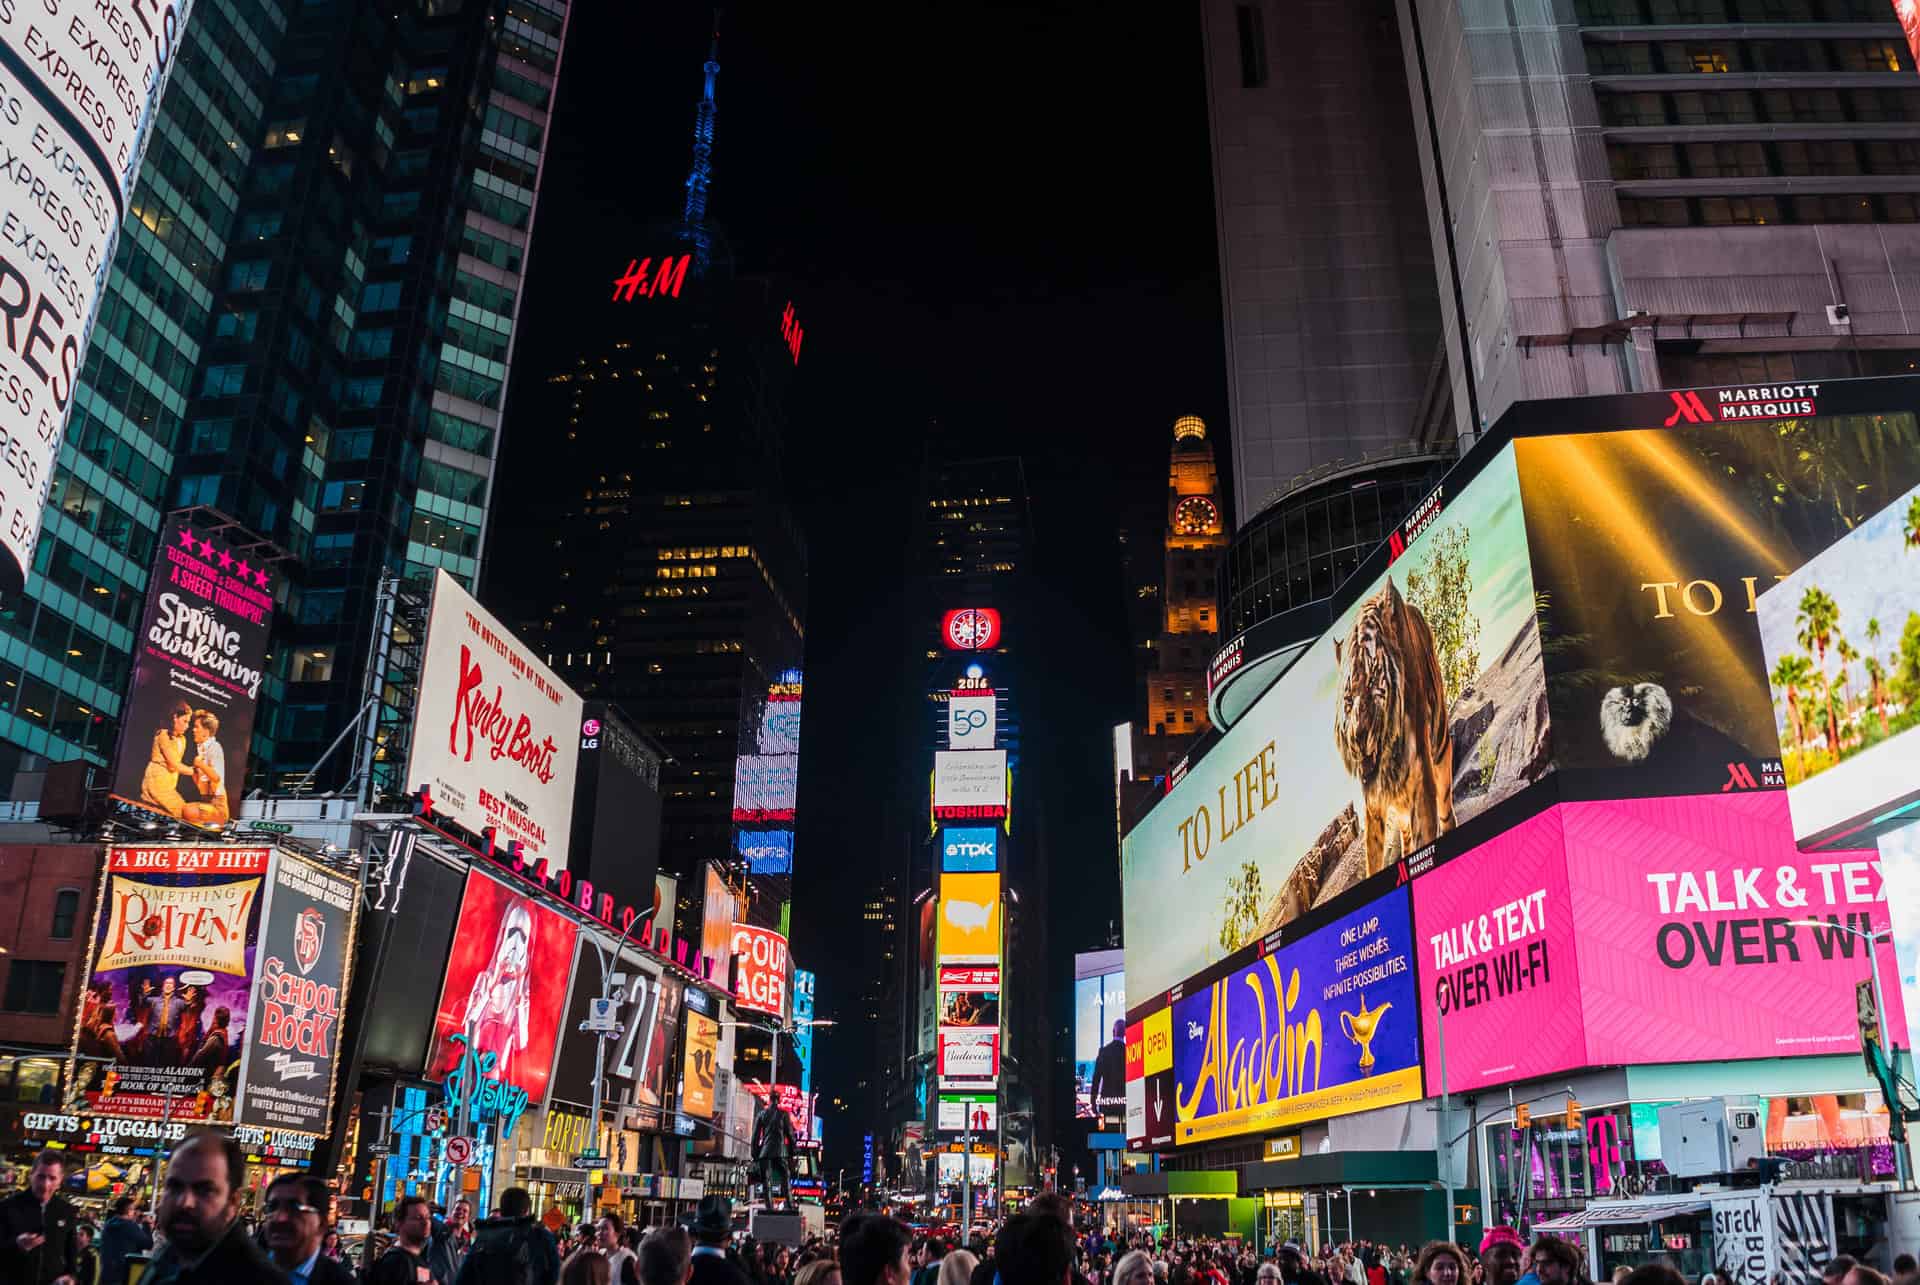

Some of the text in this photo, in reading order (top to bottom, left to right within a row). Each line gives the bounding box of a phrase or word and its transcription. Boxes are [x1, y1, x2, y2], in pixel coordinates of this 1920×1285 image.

[24, 24, 116, 144] EXPRESS
[68, 15, 142, 131] EXPRESS
[31, 123, 110, 235] EXPRESS
[2, 211, 84, 320] EXPRESS
[611, 254, 691, 302] H&M
[1718, 385, 1820, 403] MARRIOTT
[1721, 401, 1813, 419] MARQUIS
[1405, 485, 1443, 532] MARRIOTT
[1407, 505, 1441, 546] MARQUIS
[170, 565, 180, 585] A
[180, 569, 214, 601] SHEER
[1640, 579, 1723, 619] TO
[157, 592, 240, 657] SPRING
[149, 625, 263, 700] awakening
[449, 643, 512, 763] Kinky
[951, 689, 994, 697] TOSHIBA
[958, 678, 988, 689] 2016
[582, 738, 598, 749] LG
[954, 710, 987, 737] 50
[507, 712, 558, 784] Boots
[478, 788, 506, 820] BEST
[507, 806, 546, 845] MUSICAL
[935, 806, 1006, 818] TOSHIBA
[1178, 740, 1280, 875] TO LIFE
[176, 851, 212, 867] FAT
[957, 843, 994, 857] TDK
[132, 887, 236, 902] SOMETHING
[1647, 867, 1770, 914] TALK
[1776, 865, 1808, 908] &
[105, 889, 252, 959] ROTTEN!
[1340, 916, 1381, 947] ONE LAMP.
[1431, 888, 1547, 970] TALK & TEXT
[1656, 917, 1801, 970] OVER
[1335, 937, 1390, 974] THREE WISHES.
[259, 956, 338, 1017] SCHOOL
[1323, 955, 1407, 1000] INFINITE POSSIBILITIES.
[1436, 938, 1550, 1016] OVER WI-FI
[259, 1000, 332, 1058] ROCK
[616, 975, 660, 1081] 21
[1126, 1031, 1168, 1065] NOW OPEN
[1176, 953, 1323, 1123] Aladdin
[120, 1080, 144, 1090] BOOK
[147, 1081, 159, 1091] OF
[164, 1066, 204, 1076] ALADDIN
[24, 1112, 79, 1132] GIFTS
[251, 1099, 320, 1118] WINTER GARDEN THEATRE
[234, 1127, 264, 1145] GIFTS
[270, 1131, 316, 1151] LUGGAGE
[954, 1135, 980, 1143] SOY
[1715, 1200, 1762, 1234] snack
[1745, 1236, 1768, 1285] BOX
